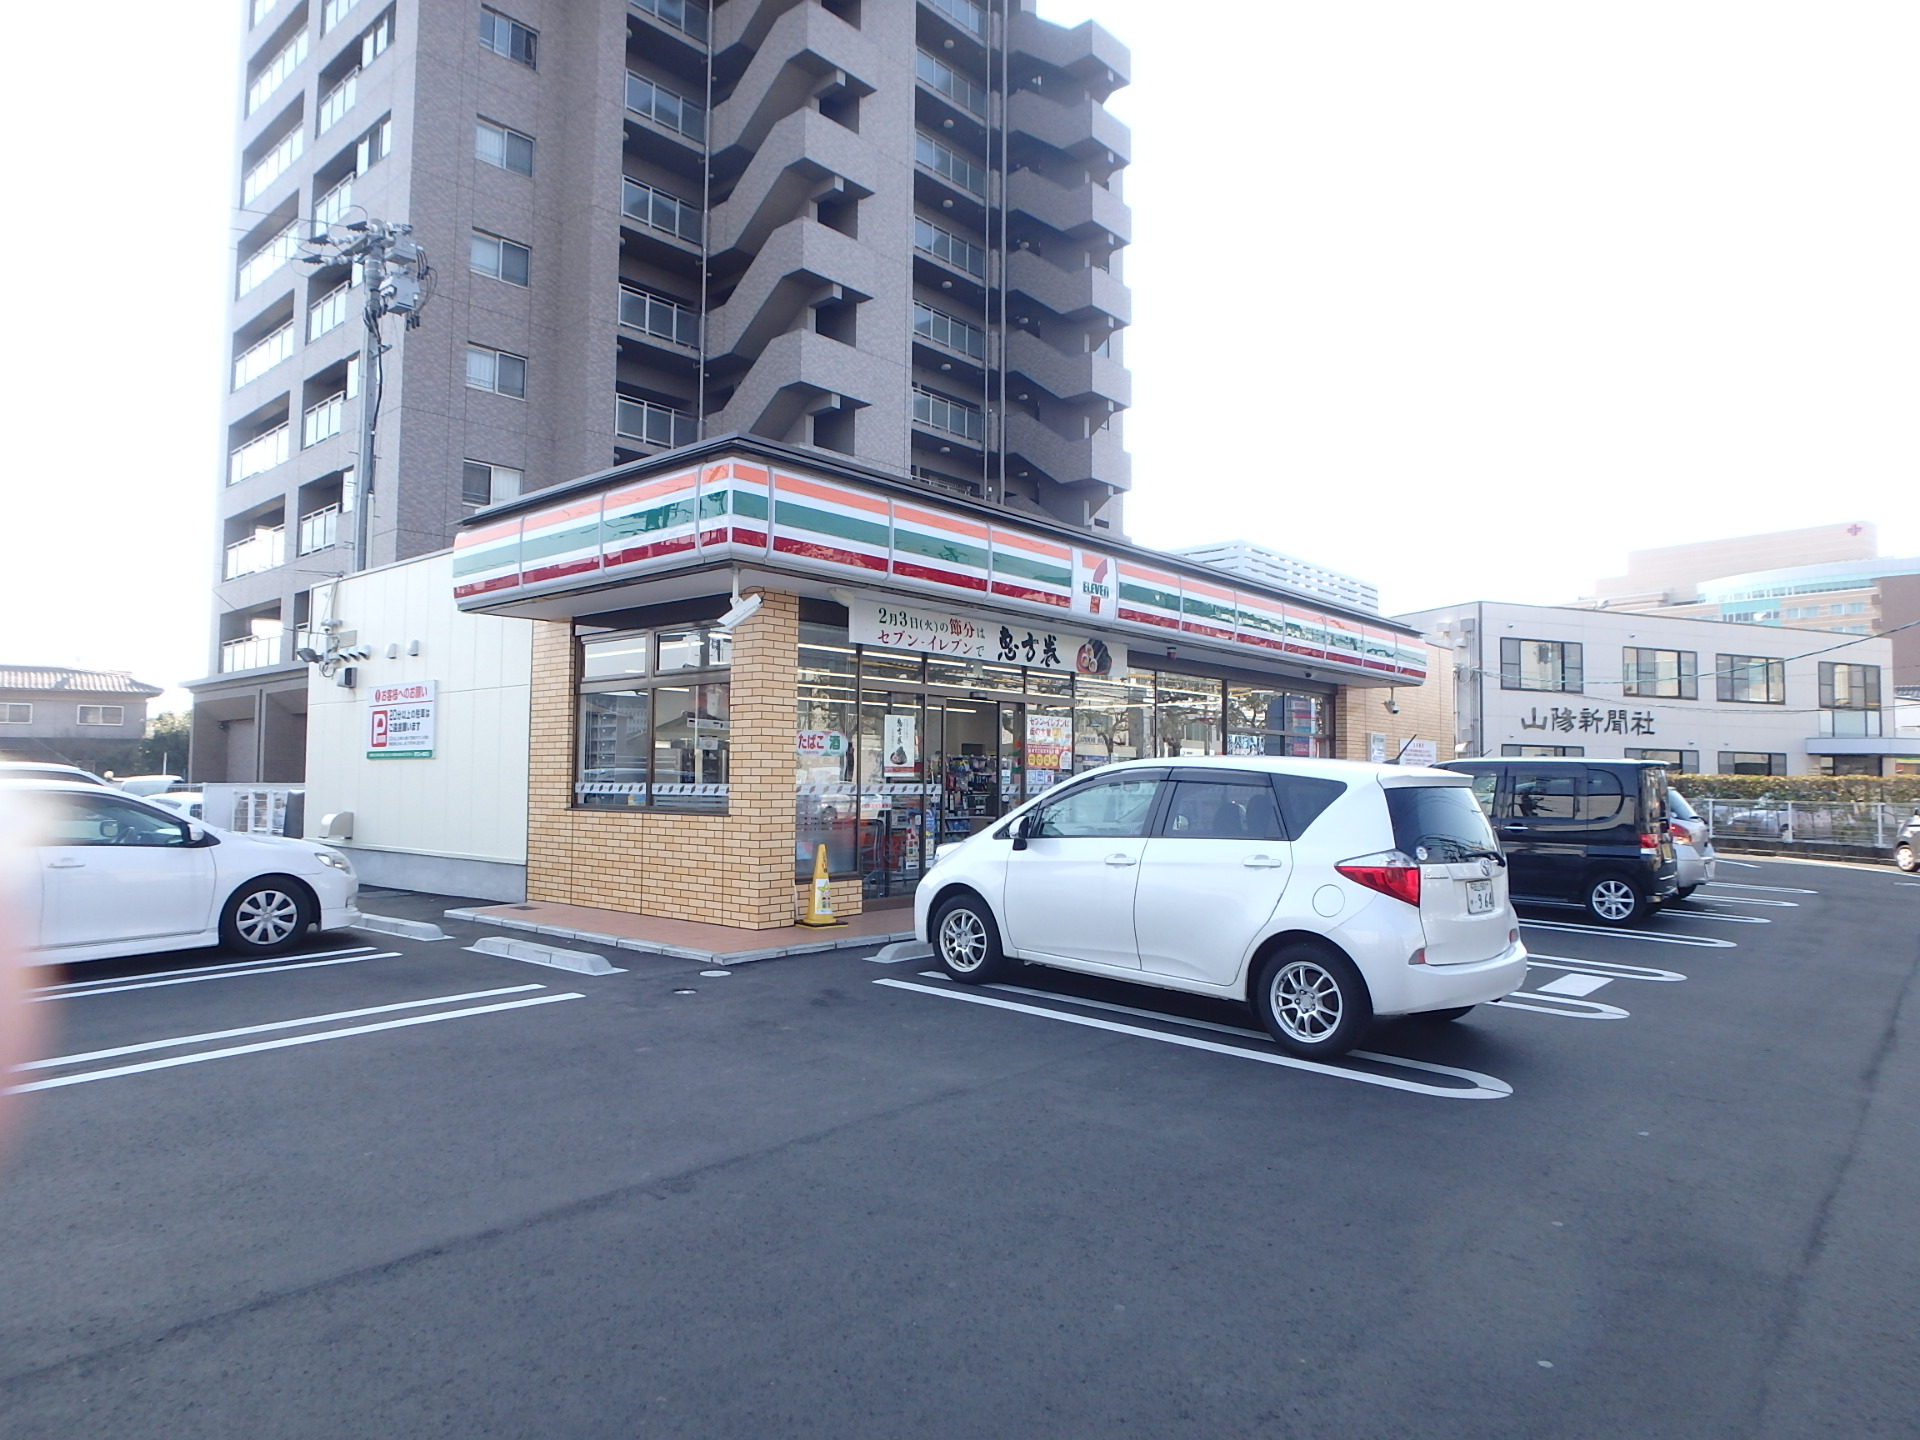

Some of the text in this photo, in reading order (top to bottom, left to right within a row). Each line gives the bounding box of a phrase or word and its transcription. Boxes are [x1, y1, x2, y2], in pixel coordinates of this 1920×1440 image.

[998, 625, 1061, 667] 恵方巻
[1521, 707, 1655, 736] 山陽新聞社
[798, 734, 840, 750] たばこ 酒
